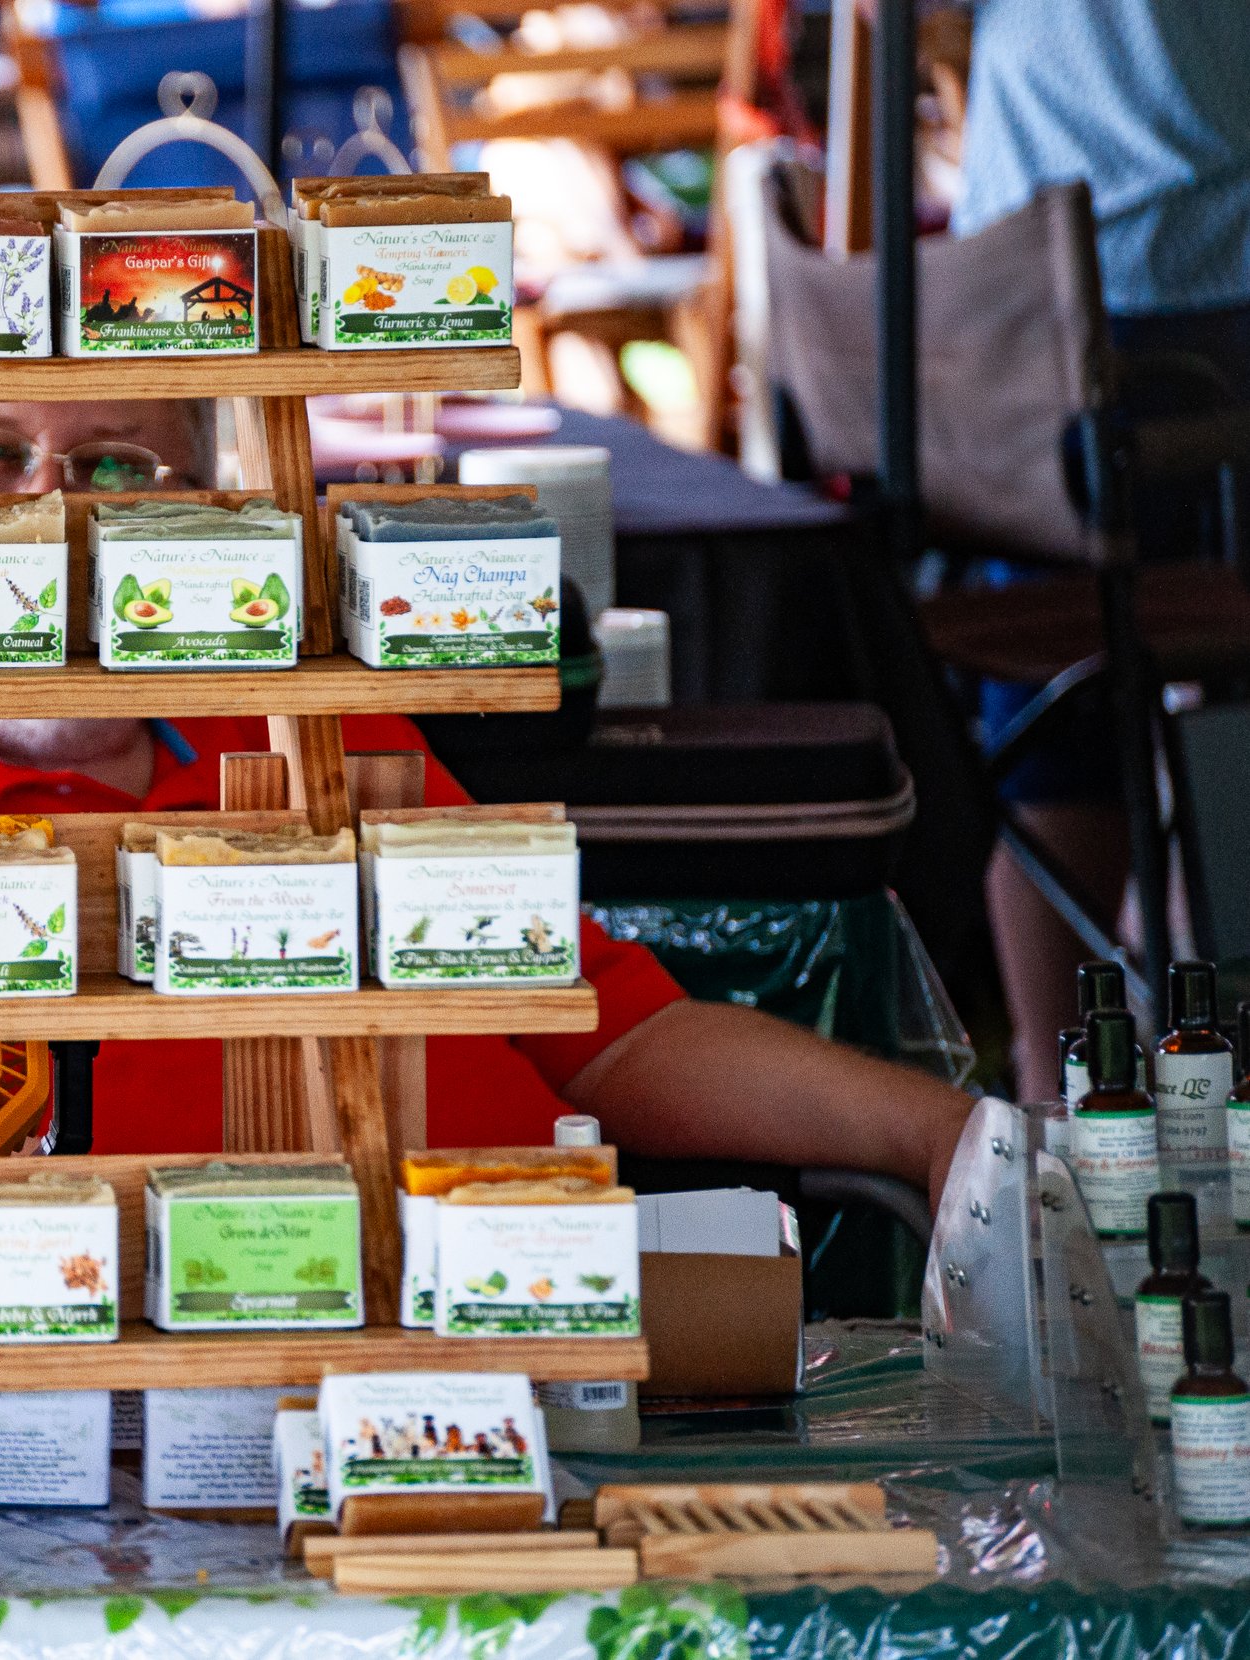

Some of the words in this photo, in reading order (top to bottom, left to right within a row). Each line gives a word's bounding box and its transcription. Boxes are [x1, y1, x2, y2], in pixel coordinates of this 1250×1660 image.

[354, 231, 417, 245] Nature's
[422, 230, 480, 243] Nuance
[99, 240, 162, 253] Nature's
[167, 239, 223, 252] Nuance
[375, 247, 420, 260] Tempting
[424, 247, 469, 257] Turmeric
[126, 256, 184, 270] Gaspar's
[188, 255, 210, 268] Gift
[374, 316, 424, 329] Turmeric
[428, 319, 437, 327] &
[440, 314, 472, 329] Lemon
[100, 324, 170, 338] Frankincense
[174, 325, 186, 335] &
[190, 323, 231, 338] Myrrh
[130, 549, 196, 562] Nature's
[200, 549, 258, 562] Nuance
[399, 553, 464, 565] Nature's
[468, 551, 526, 563] Nuance
[414, 565, 459, 586] Nag
[464, 565, 526, 586] Champa
[412, 589, 492, 606] Handcrafted
[495, 587, 526, 601] Soap
[3, 636, 43, 647] Oatmeal
[172, 636, 227, 648] Avocado
[447, 882, 517, 898] Somerset
[30, 1308, 43, 1323] &
[46, 1308, 98, 1325] Myrrh
